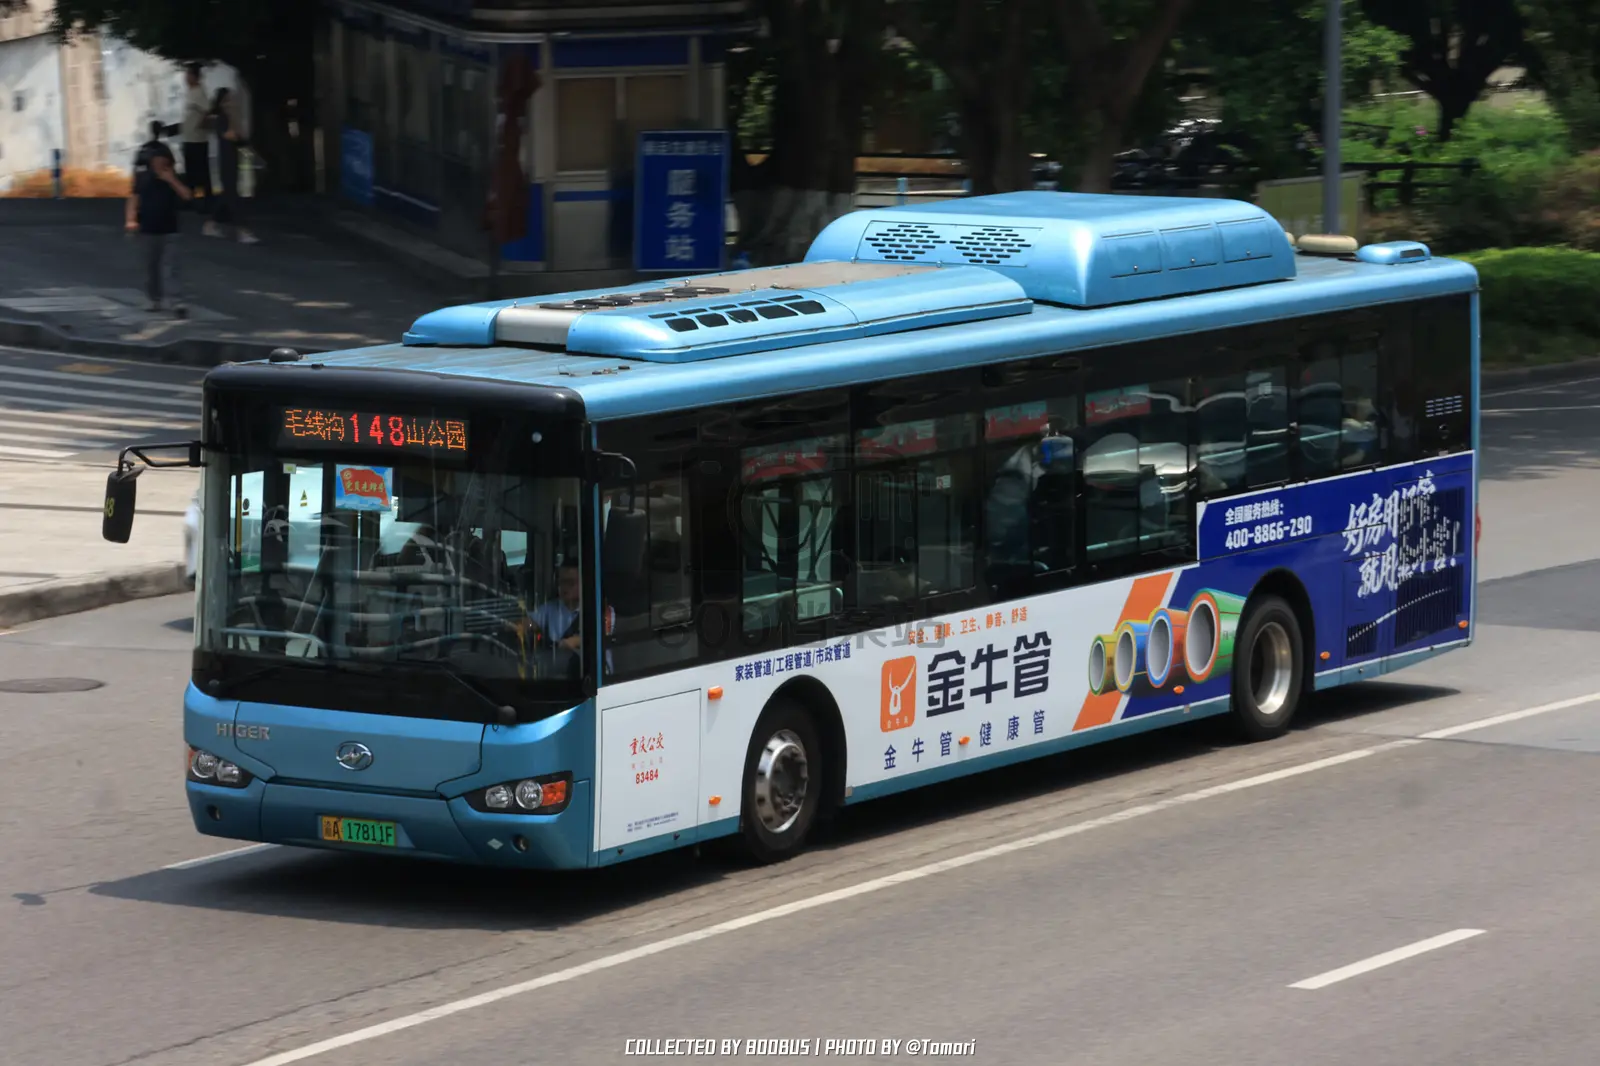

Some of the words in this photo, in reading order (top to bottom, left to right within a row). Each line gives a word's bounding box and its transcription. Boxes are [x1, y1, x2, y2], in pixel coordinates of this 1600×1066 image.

[285, 409, 345, 441] 毛线沟
[350, 413, 405, 446] 148
[406, 418, 467, 450] 山公园
[1225, 515, 1312, 549] 400-8866-290
[735, 641, 851, 682] 家装管道/工程管道/市政管道
[926, 631, 1051, 718] 金牛管
[216, 722, 270, 741] HIGER
[629, 732, 664, 756] 重庆公交
[883, 731, 952, 770] 金牛管
[979, 709, 1046, 747] 健康管
[635, 768, 659, 784] 83484
